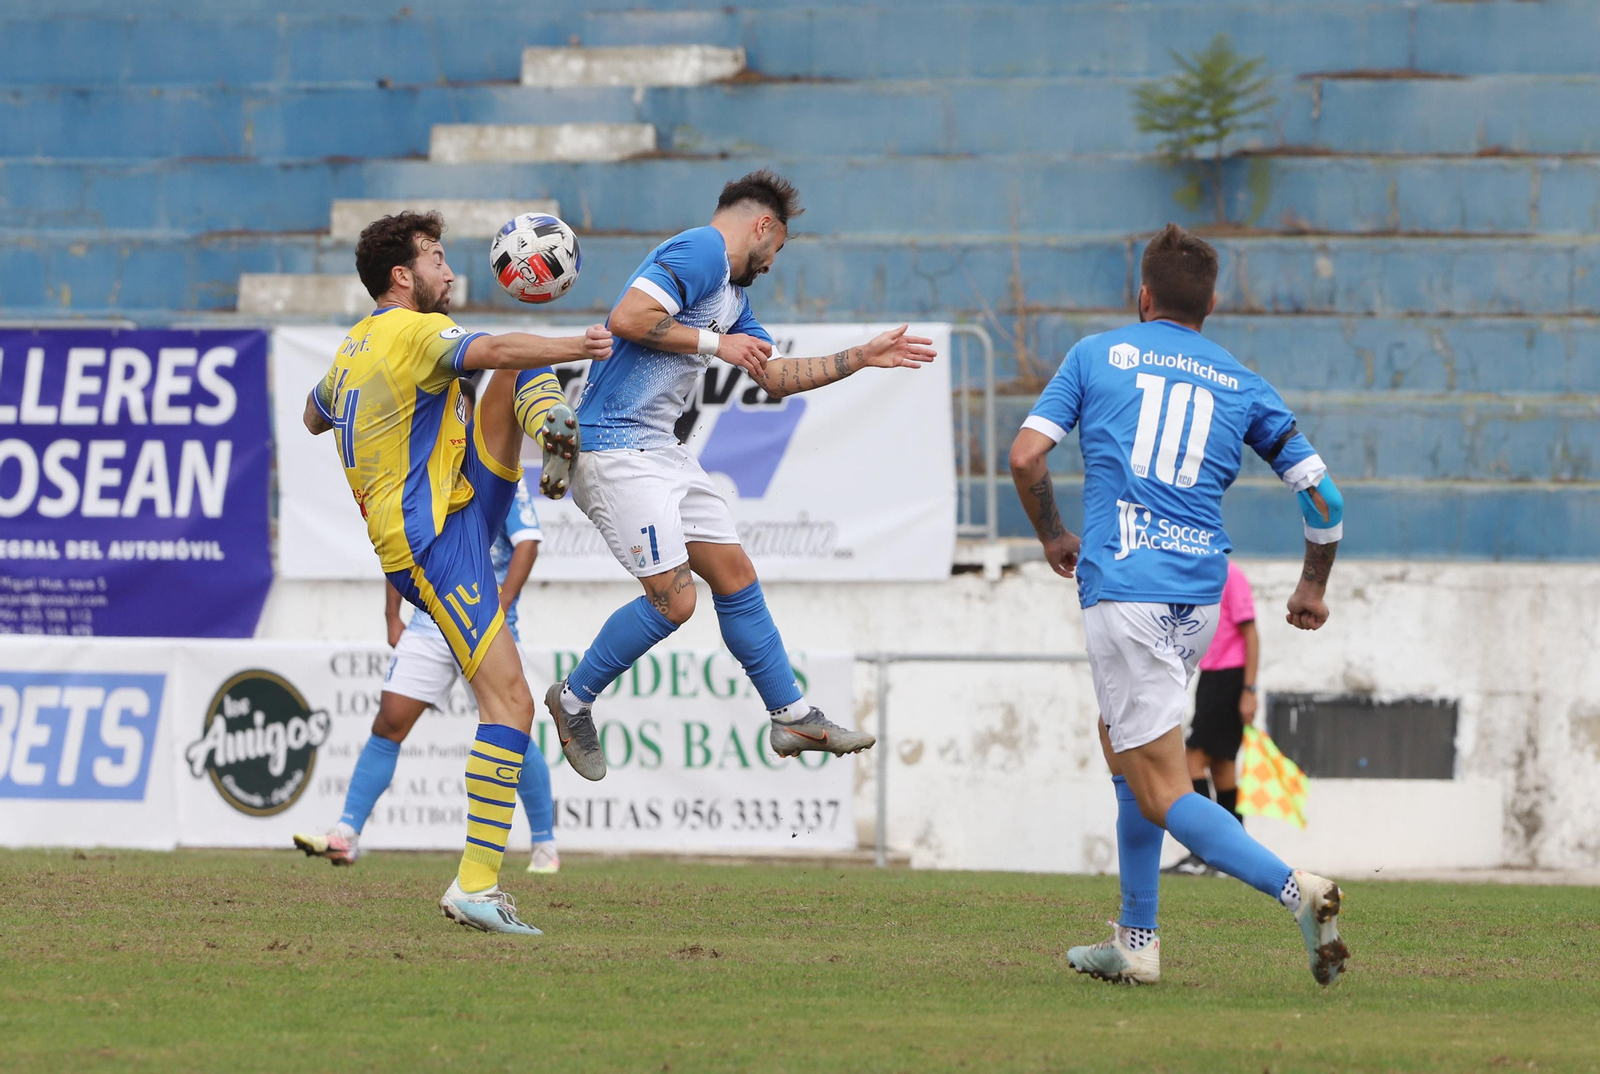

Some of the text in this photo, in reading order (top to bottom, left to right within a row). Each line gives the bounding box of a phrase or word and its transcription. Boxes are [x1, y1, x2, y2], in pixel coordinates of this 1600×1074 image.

[1142, 350, 1239, 390] duokitchen
[1130, 372, 1215, 488] 10
[0, 438, 233, 518] OSEAN
[65, 539, 104, 560] DEL
[108, 537, 225, 561] AUTOMÓVIL
[1158, 519, 1215, 546] Soccer
[330, 651, 387, 677] CER
[554, 650, 809, 699] BDEG
[186, 710, 330, 778] Amigos
[552, 797, 841, 831] ISITAS 956 333 337
